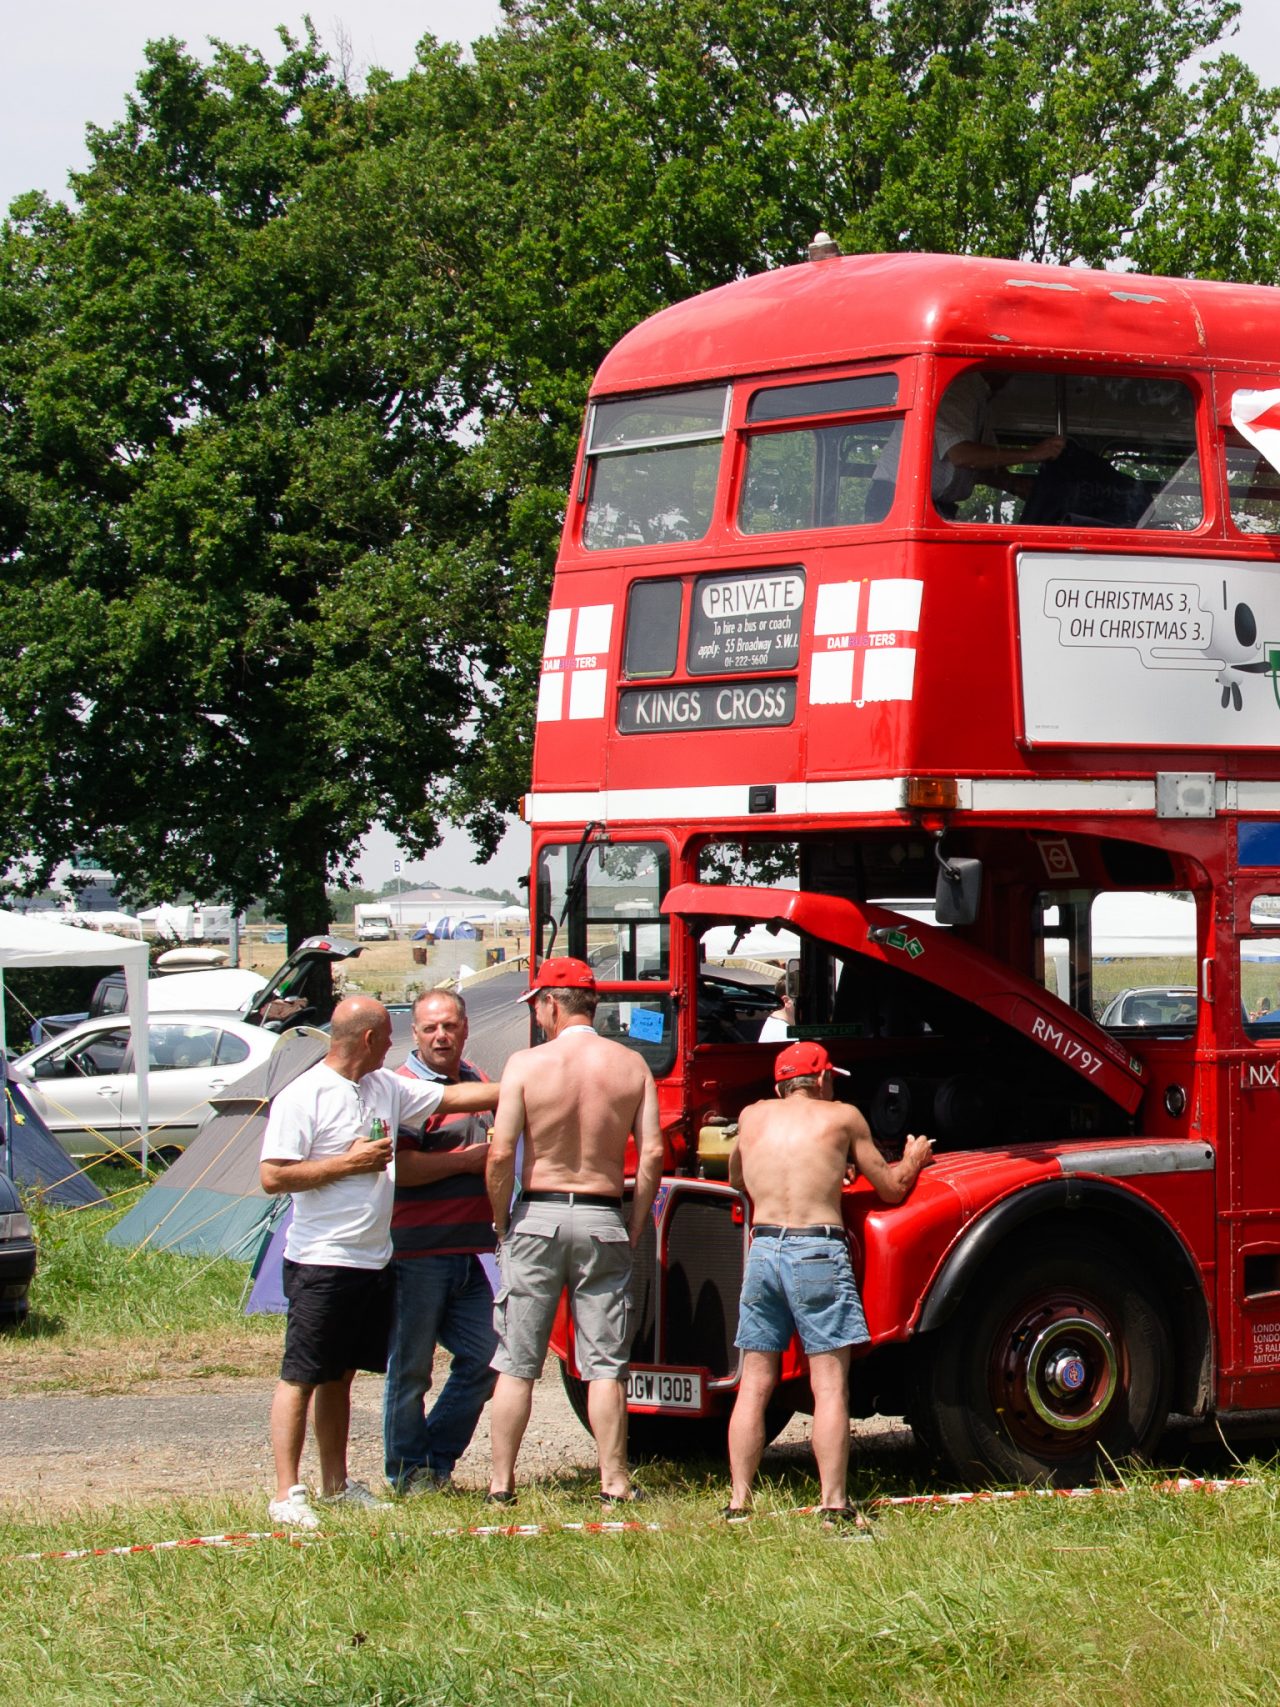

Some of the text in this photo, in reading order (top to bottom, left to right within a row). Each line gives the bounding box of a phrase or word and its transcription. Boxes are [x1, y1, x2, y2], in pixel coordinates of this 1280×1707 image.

[709, 580, 795, 614] PRIVATE
[1055, 589, 1191, 614] OH CHRISTMAS 3,
[713, 614, 791, 635] To hire a bus or coach
[1070, 618, 1205, 641] OH CHRISTMAS 3.
[725, 638, 735, 654] 55
[737, 636, 772, 654] Broadway
[635, 687, 786, 724] KINGS CROSS
[1249, 1064, 1277, 1085] NX
[1254, 1344, 1263, 1354] 25
[659, 1376, 692, 1402] 130B
